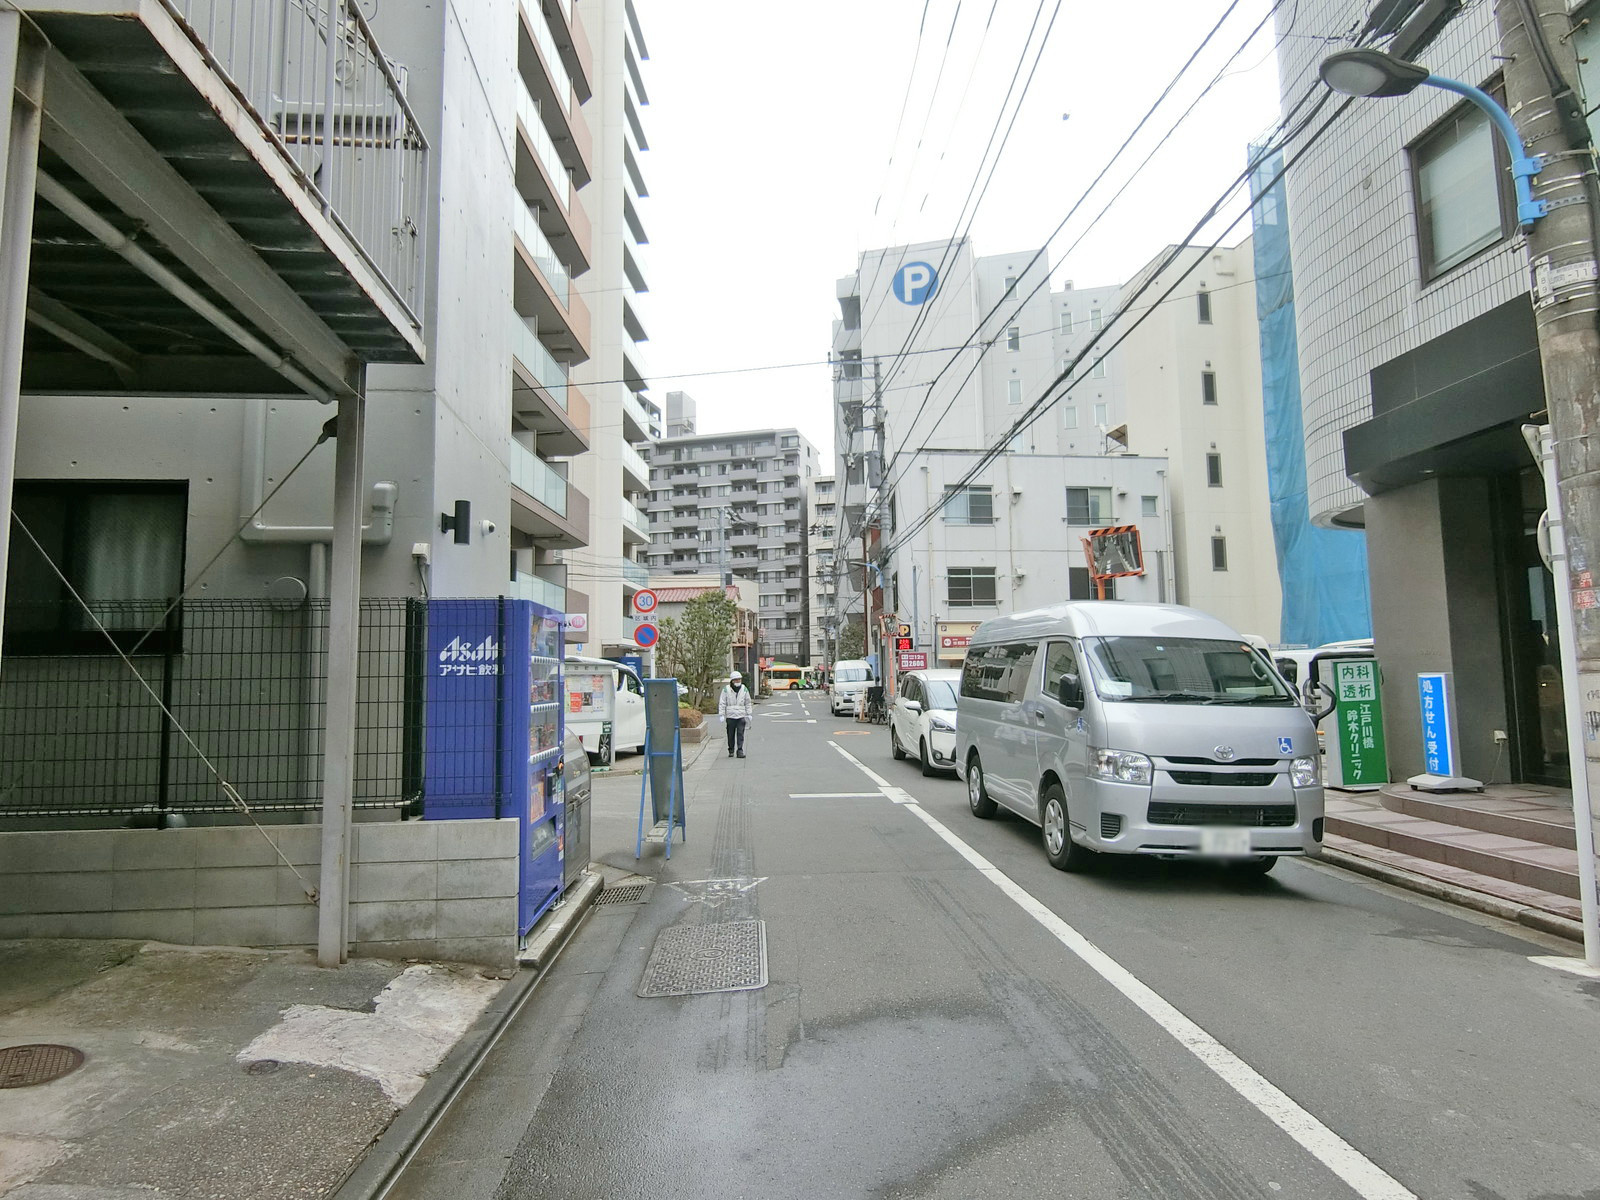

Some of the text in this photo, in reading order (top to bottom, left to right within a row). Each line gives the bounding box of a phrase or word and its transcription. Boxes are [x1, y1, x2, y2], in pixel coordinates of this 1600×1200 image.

[903, 265, 930, 303] P
[639, 595, 653, 607] 30
[1342, 664, 1370, 680] 内科
[1343, 683, 1372, 699] 透析
[1359, 703, 1375, 749] 江戸川橋
[1423, 680, 1439, 771] 処方せん受付
[1346, 709, 1363, 781] 鈴木クリニック
